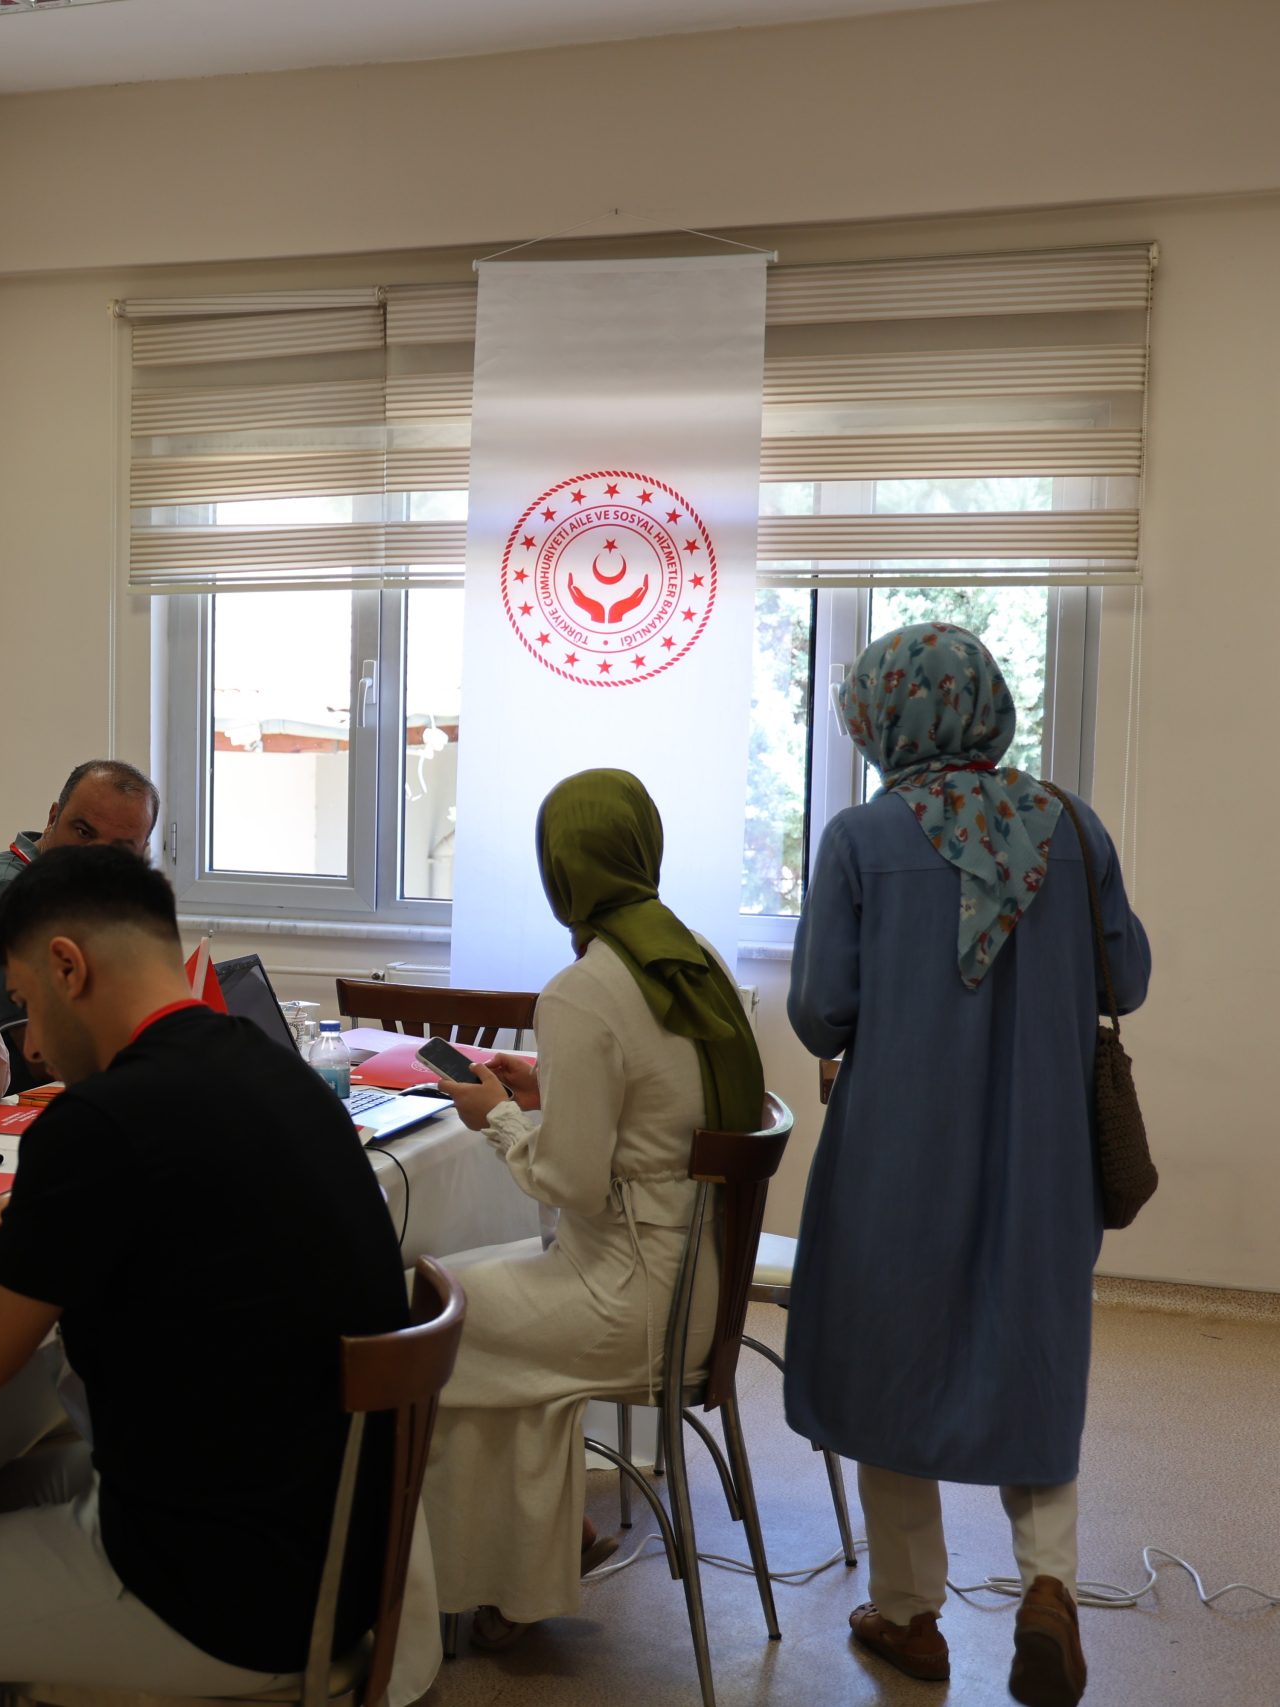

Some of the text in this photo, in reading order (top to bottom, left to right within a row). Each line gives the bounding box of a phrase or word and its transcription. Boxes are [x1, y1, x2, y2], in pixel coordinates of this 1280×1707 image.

[539, 509, 678, 647] TÜRKİYE CUMHURİYETİ AİLE VE SOSYAL HİZMETLER BAKANLIĞI
